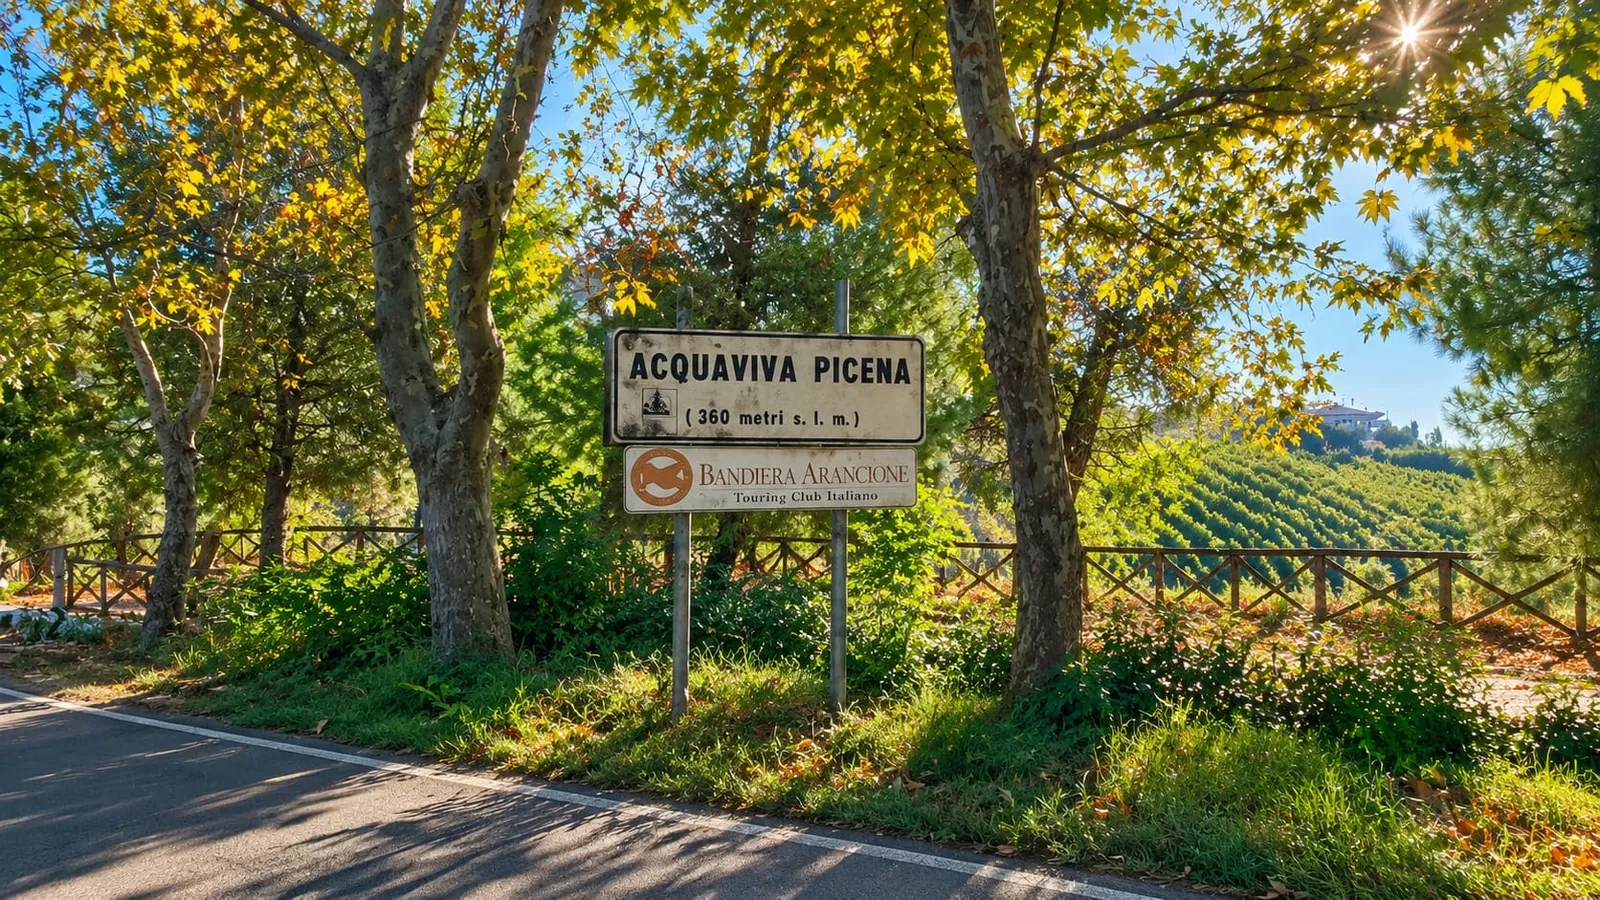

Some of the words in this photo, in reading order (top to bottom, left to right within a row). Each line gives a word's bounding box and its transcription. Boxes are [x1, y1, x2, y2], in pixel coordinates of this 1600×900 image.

[629, 353, 797, 383] ACQUAVIVA
[814, 357, 911, 385] PICENA
[739, 410, 784, 425] metri
[793, 414, 806, 426] s.
[699, 463, 796, 486] BANDIERA
[802, 462, 909, 485] ARANCIONE
[733, 492, 787, 505] Touring
[791, 491, 822, 503] Club
[826, 491, 879, 502] Italiano
